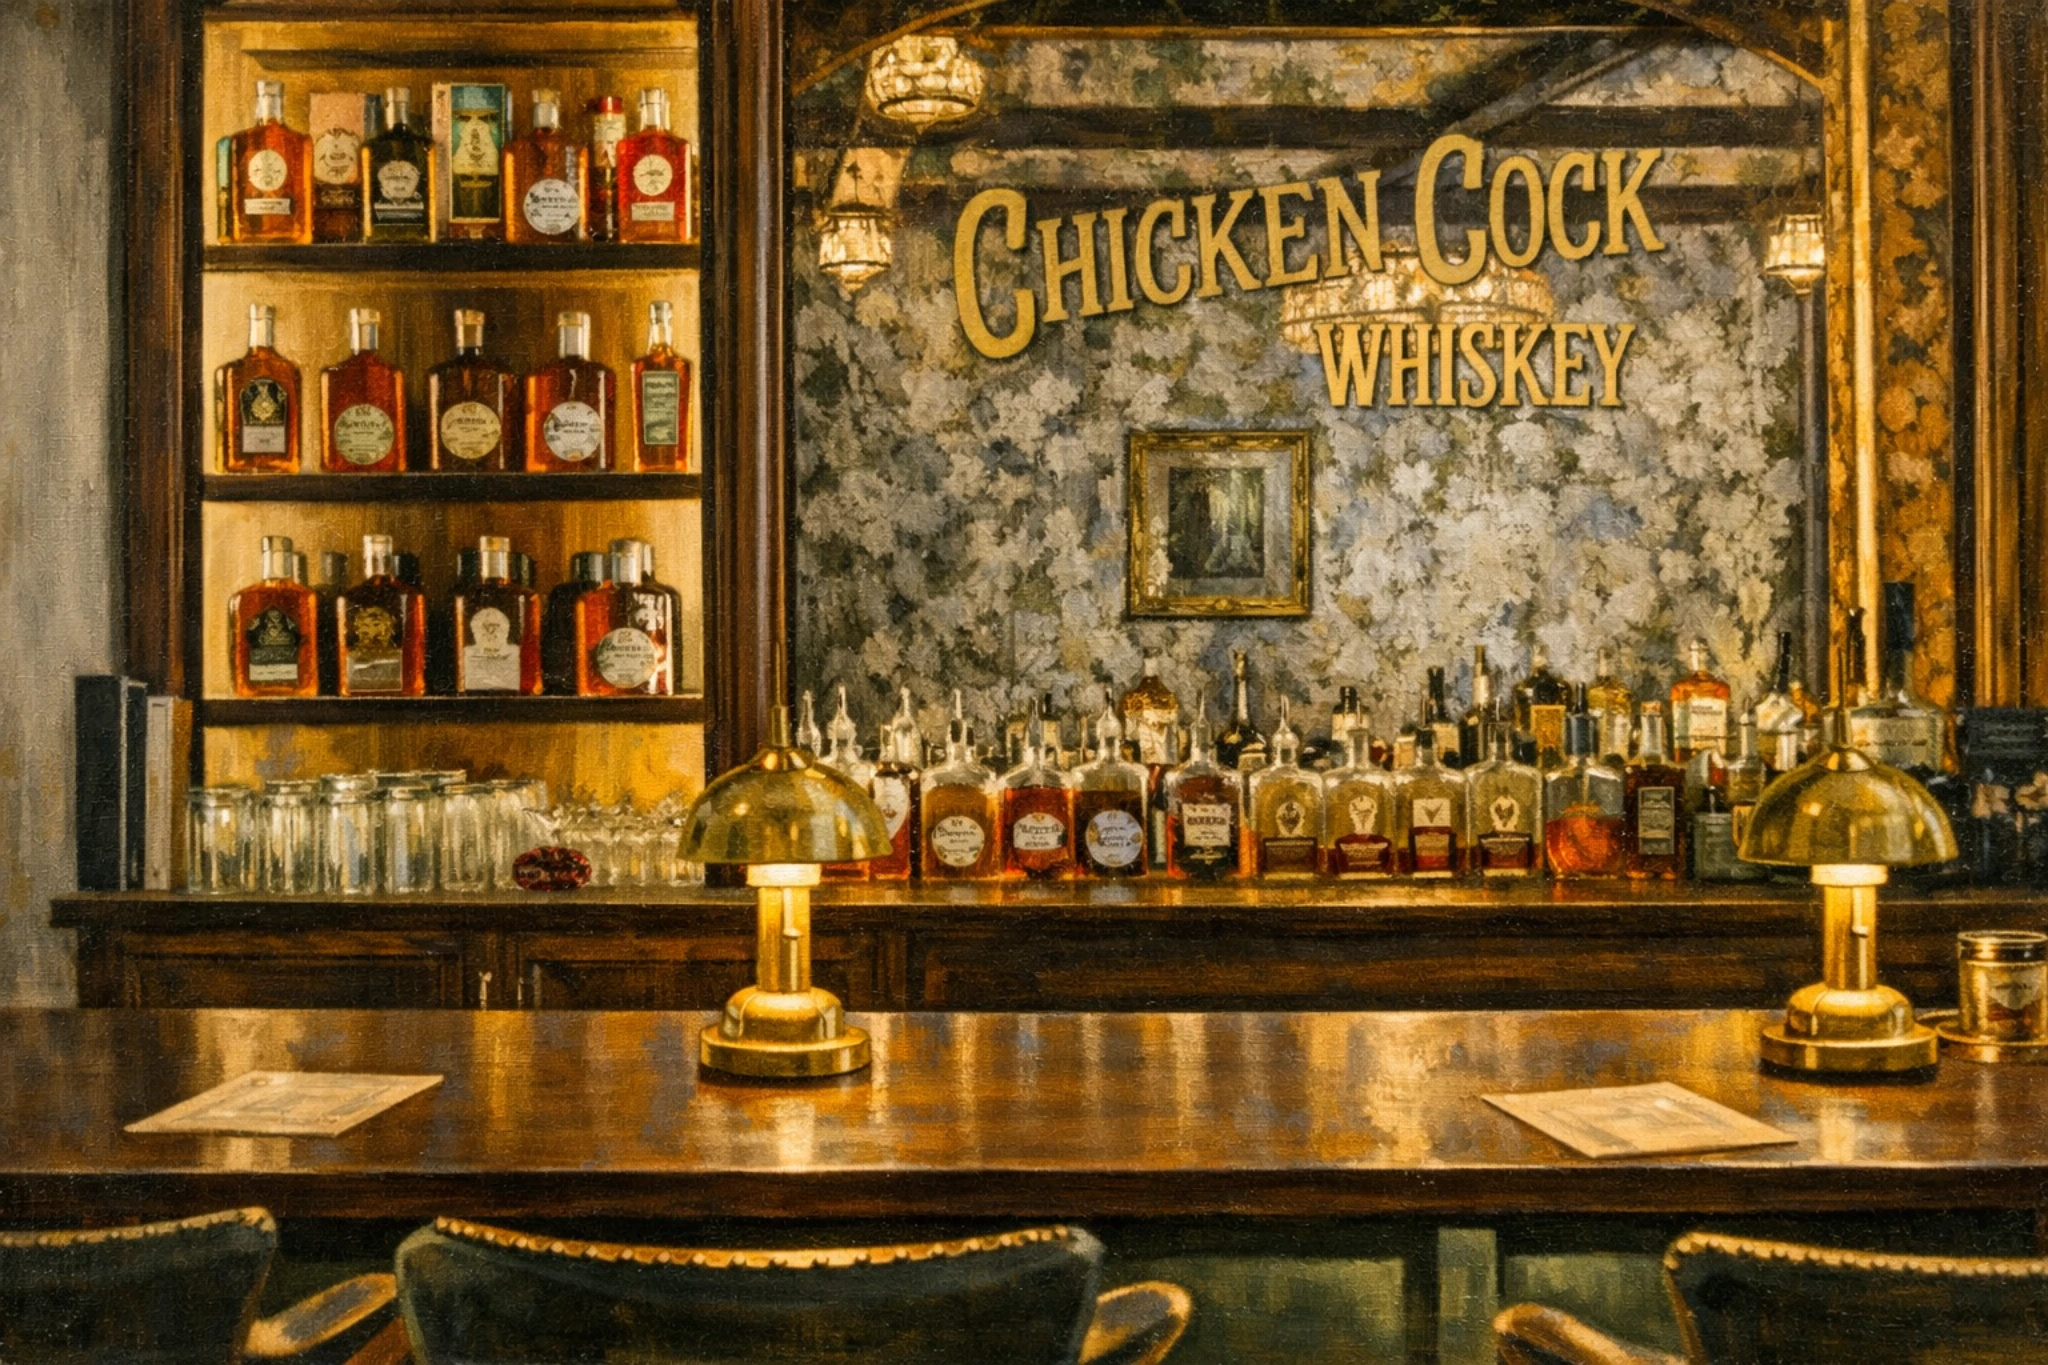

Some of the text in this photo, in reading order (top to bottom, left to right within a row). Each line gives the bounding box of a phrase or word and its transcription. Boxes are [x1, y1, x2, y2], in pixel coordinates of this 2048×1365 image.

[953, 134, 1665, 358] CHICKEN COCK
[1314, 322, 1636, 408] WHISKEY
